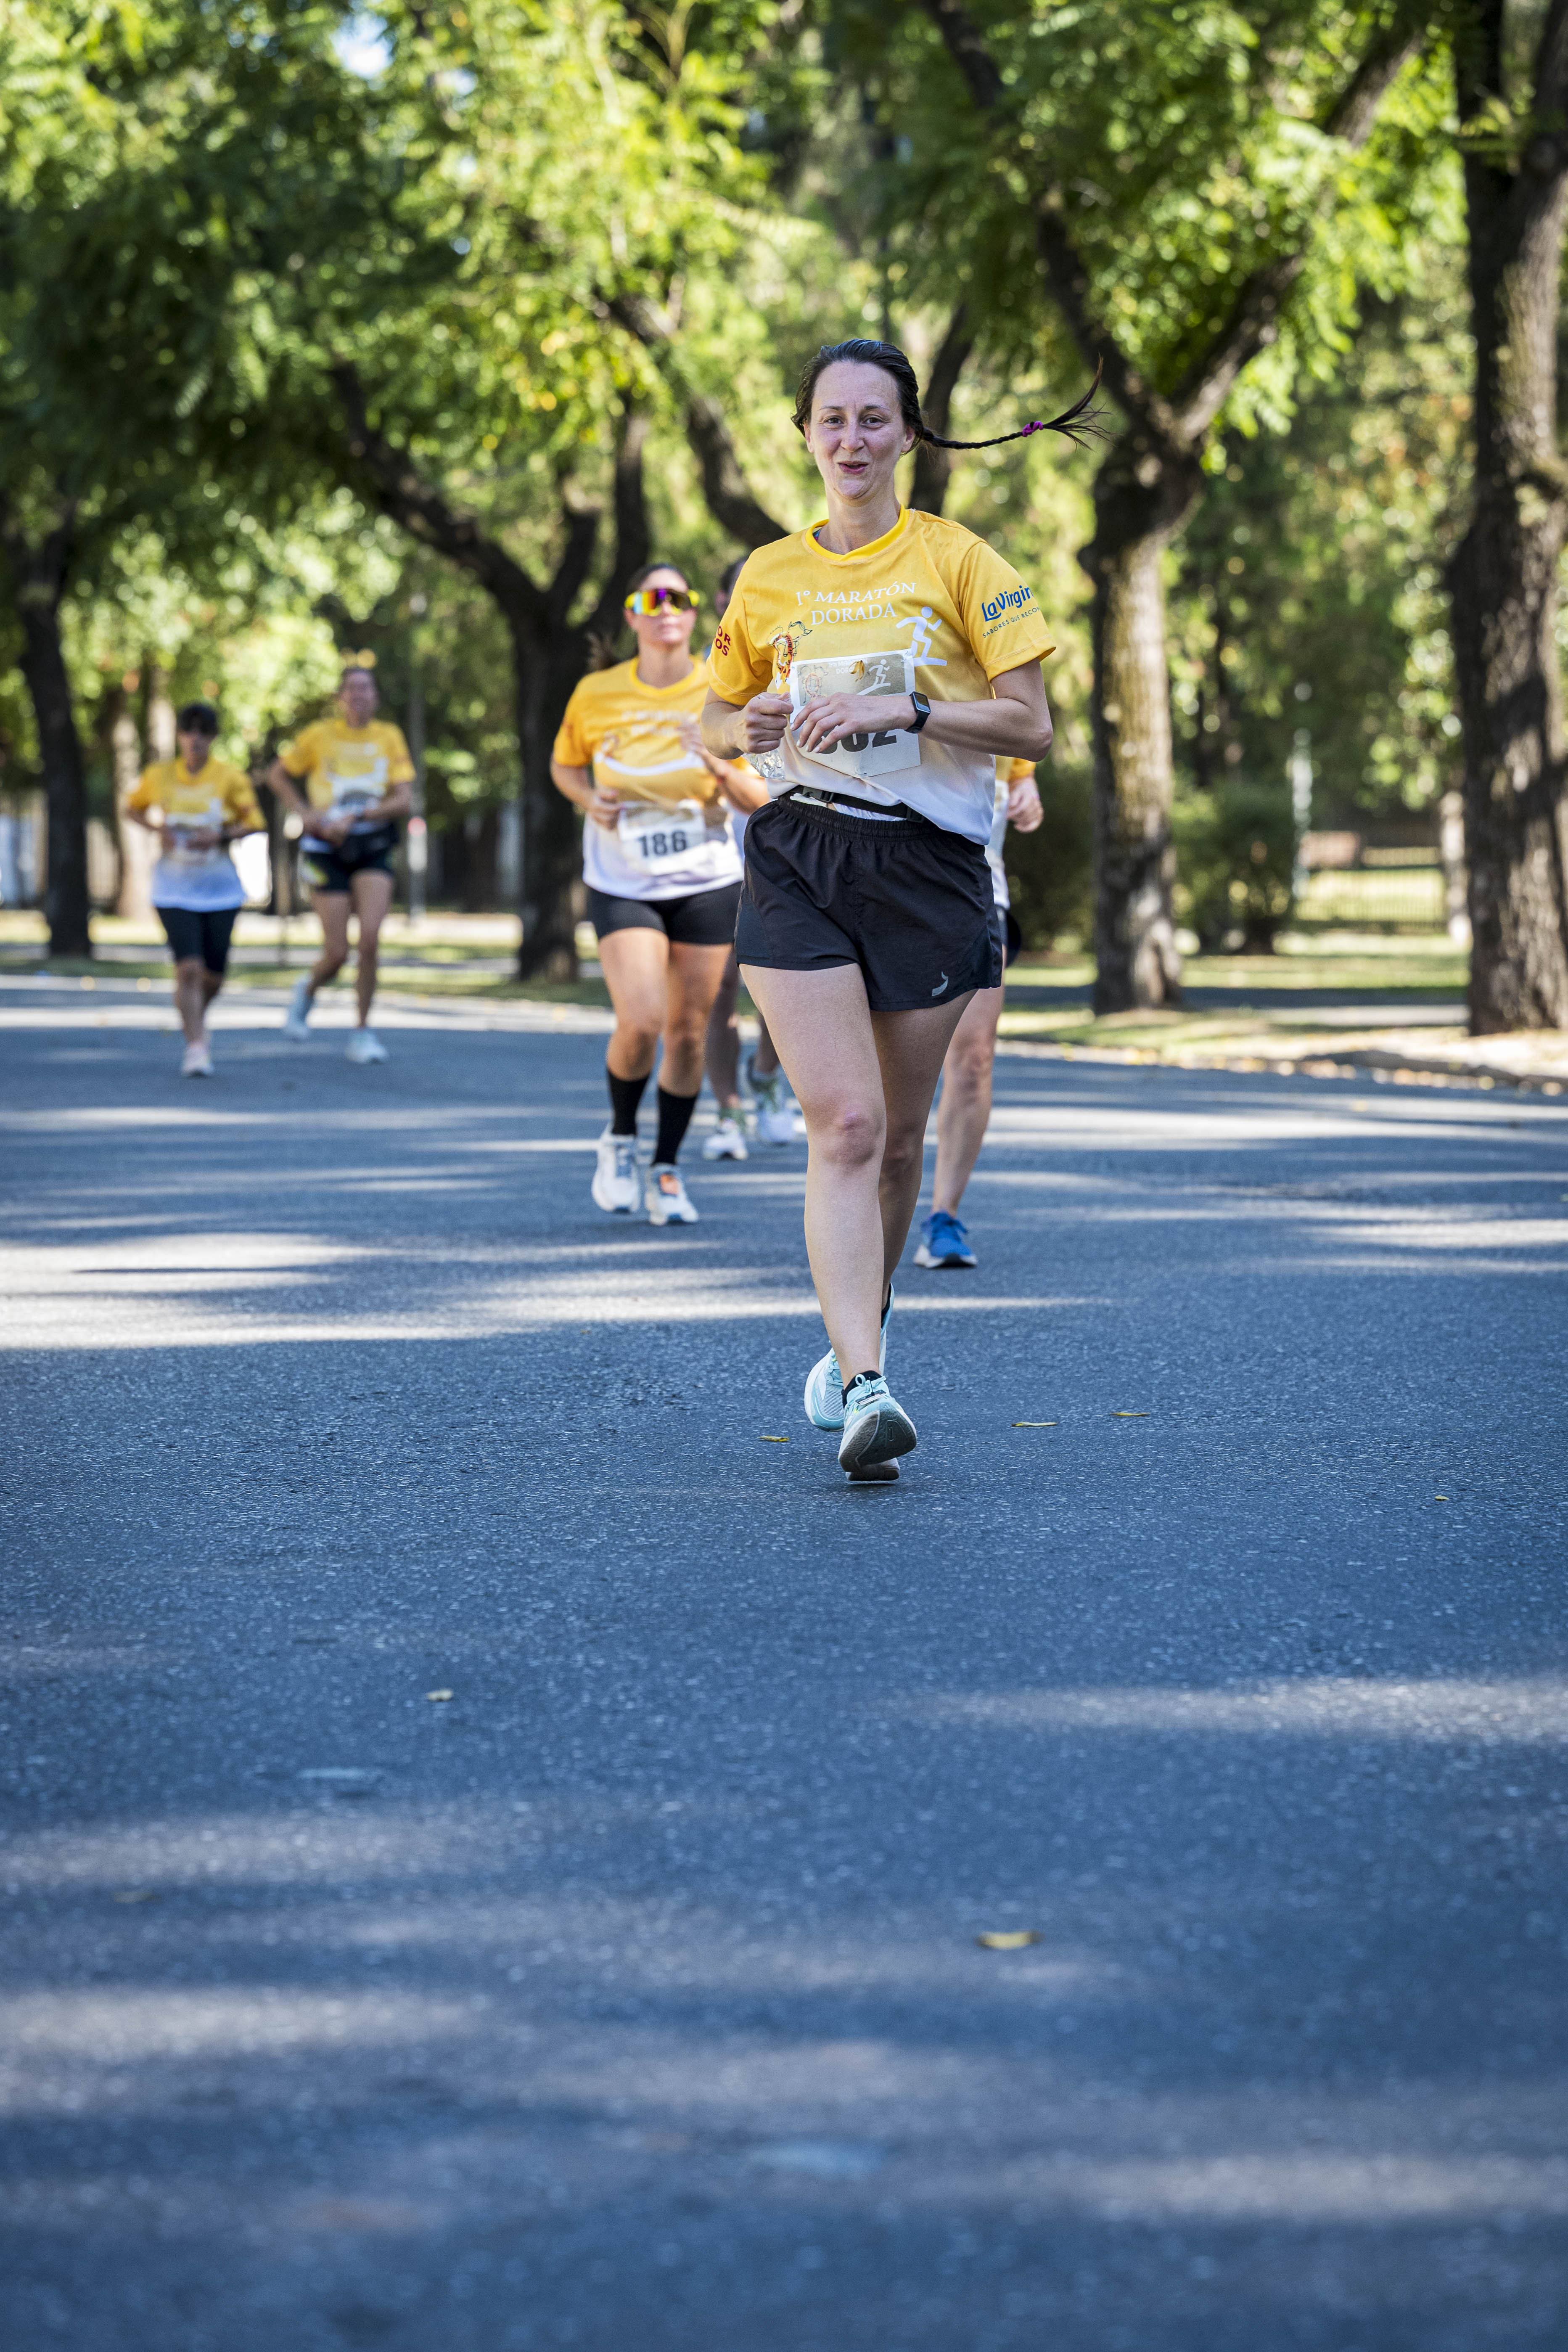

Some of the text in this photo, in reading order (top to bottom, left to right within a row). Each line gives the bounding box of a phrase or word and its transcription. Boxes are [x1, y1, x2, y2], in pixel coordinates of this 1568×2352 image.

[814, 581, 917, 604] MARATÓN
[811, 602, 897, 625] DORADA
[983, 619, 1010, 638] SABORES
[639, 831, 687, 857] 186
